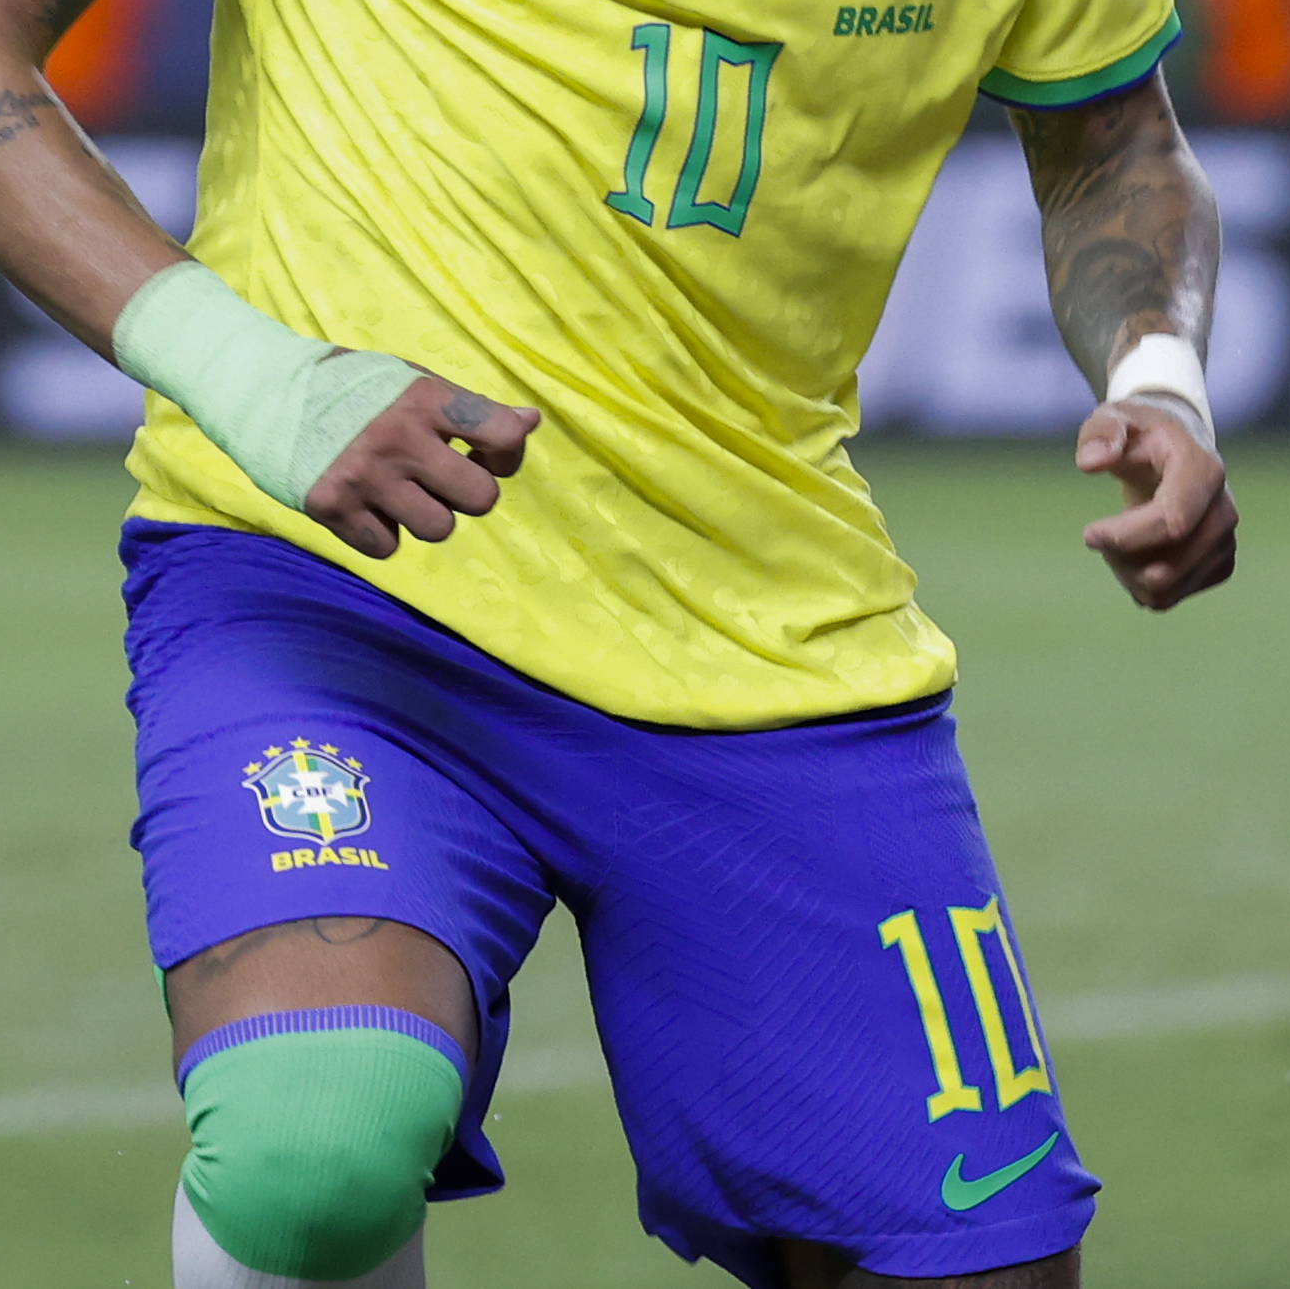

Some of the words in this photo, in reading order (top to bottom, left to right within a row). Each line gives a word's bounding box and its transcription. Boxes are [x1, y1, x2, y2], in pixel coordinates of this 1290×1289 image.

[832, 3, 935, 37] BRASIL
[604, 22, 785, 238] 10
[270, 846, 389, 872] BRASIL
[877, 893, 1052, 1123] 10
